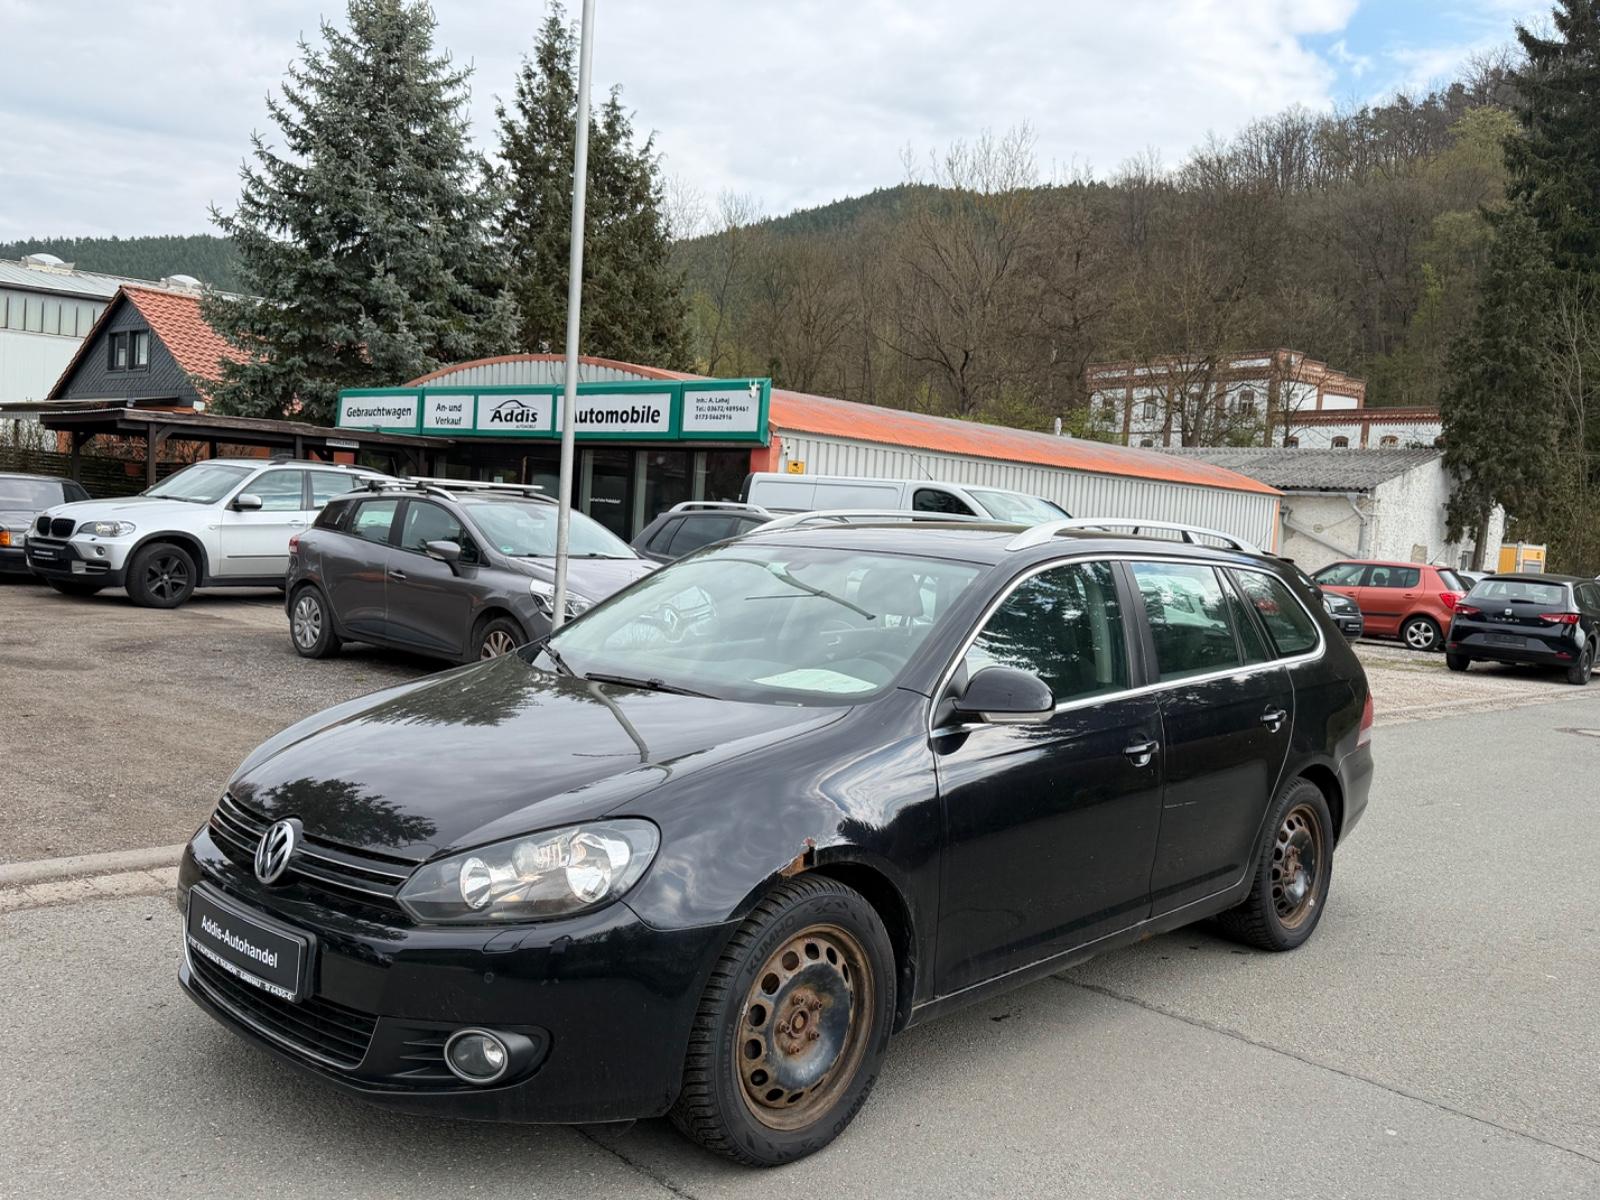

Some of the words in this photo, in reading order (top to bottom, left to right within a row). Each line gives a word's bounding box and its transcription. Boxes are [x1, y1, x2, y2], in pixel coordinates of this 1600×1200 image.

[346, 407, 412, 419] Gebrauchtwagen
[436, 403, 447, 412] An-
[448, 403, 462, 412] und
[435, 416, 462, 425] Verkauf
[490, 409, 538, 423] Addis
[201, 915, 278, 968] Addis-Autohandel
